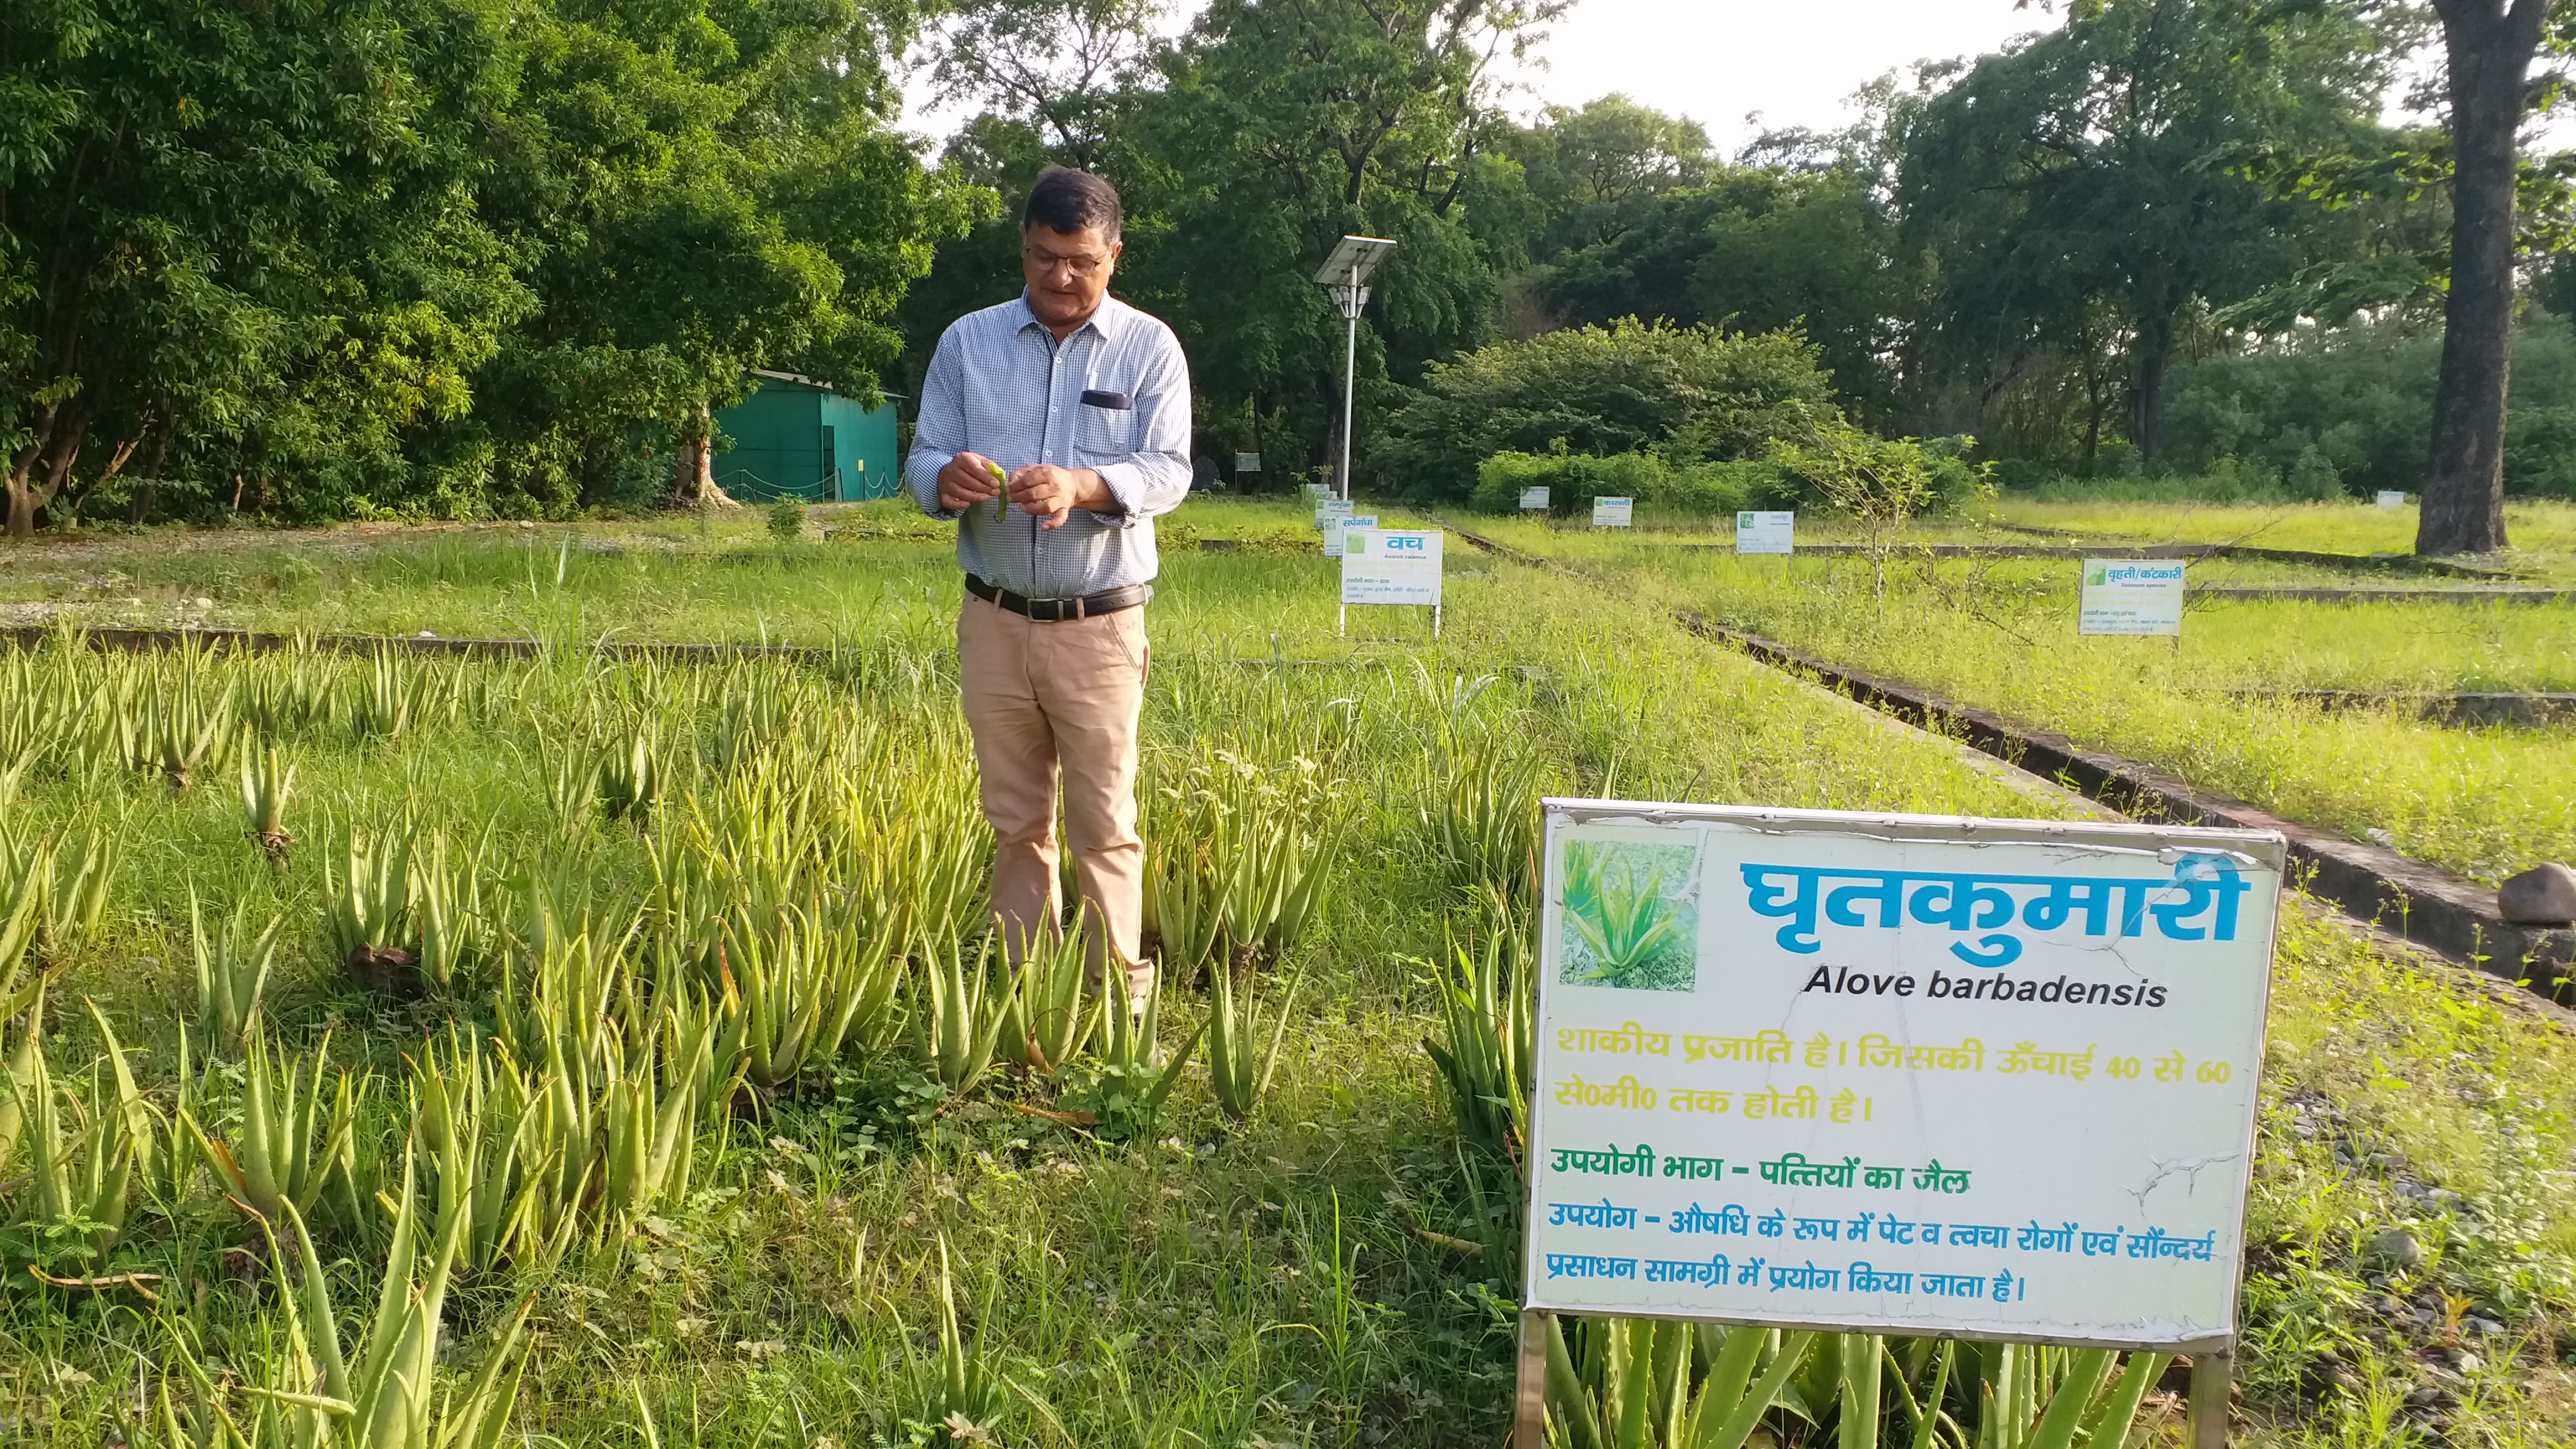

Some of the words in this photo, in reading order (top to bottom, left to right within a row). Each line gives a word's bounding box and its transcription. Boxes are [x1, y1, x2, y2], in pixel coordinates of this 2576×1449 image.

[1386, 537, 1425, 550] वच
[1740, 852, 2251, 969] घृतकुमारी
[1805, 966, 1915, 997] Alove
[1926, 969, 2168, 1007] barbadensis
[1557, 1021, 1673, 1057] शाकीय
[1682, 1029, 1794, 1063] प्रजाति
[1857, 1033, 1986, 1072] जिसकी
[1996, 1040, 2097, 1081] ऊँचाई
[2105, 1056, 2140, 1079] 40
[2153, 1049, 2187, 1081] से
[2196, 1061, 2231, 1084] 60
[1668, 1088, 1733, 1113] तक
[1743, 1085, 1820, 1119] होती
[1551, 1143, 1655, 1177] उपयोगी
[1663, 1156, 1723, 1181] भाग
[1759, 1153, 1861, 1188] पत्तियों
[1864, 1166, 1905, 1190] का
[1911, 1159, 1972, 1194] जैल
[1548, 1197, 1637, 1229] उपयोग
[1668, 1202, 1750, 1235] औषधि
[1757, 1208, 1786, 1238] के
[1793, 1218, 1840, 1241] रूप
[1847, 1212, 1876, 1242] में
[1878, 1213, 1916, 1244] पेट
[1921, 1224, 1942, 1245] व
[1949, 1224, 2010, 1249] त्वचा
[2017, 1219, 2078, 1252] रोगों
[2081, 1225, 2124, 1256] एवं
[1546, 1253, 1637, 1280] प्रसाधन
[1645, 1254, 1730, 1288] सामग्री
[1737, 1257, 1765, 1287] में
[1769, 1260, 1840, 1292] प्रयोग
[1848, 1261, 1914, 1294] किया
[1920, 1274, 1986, 1298] जाता
